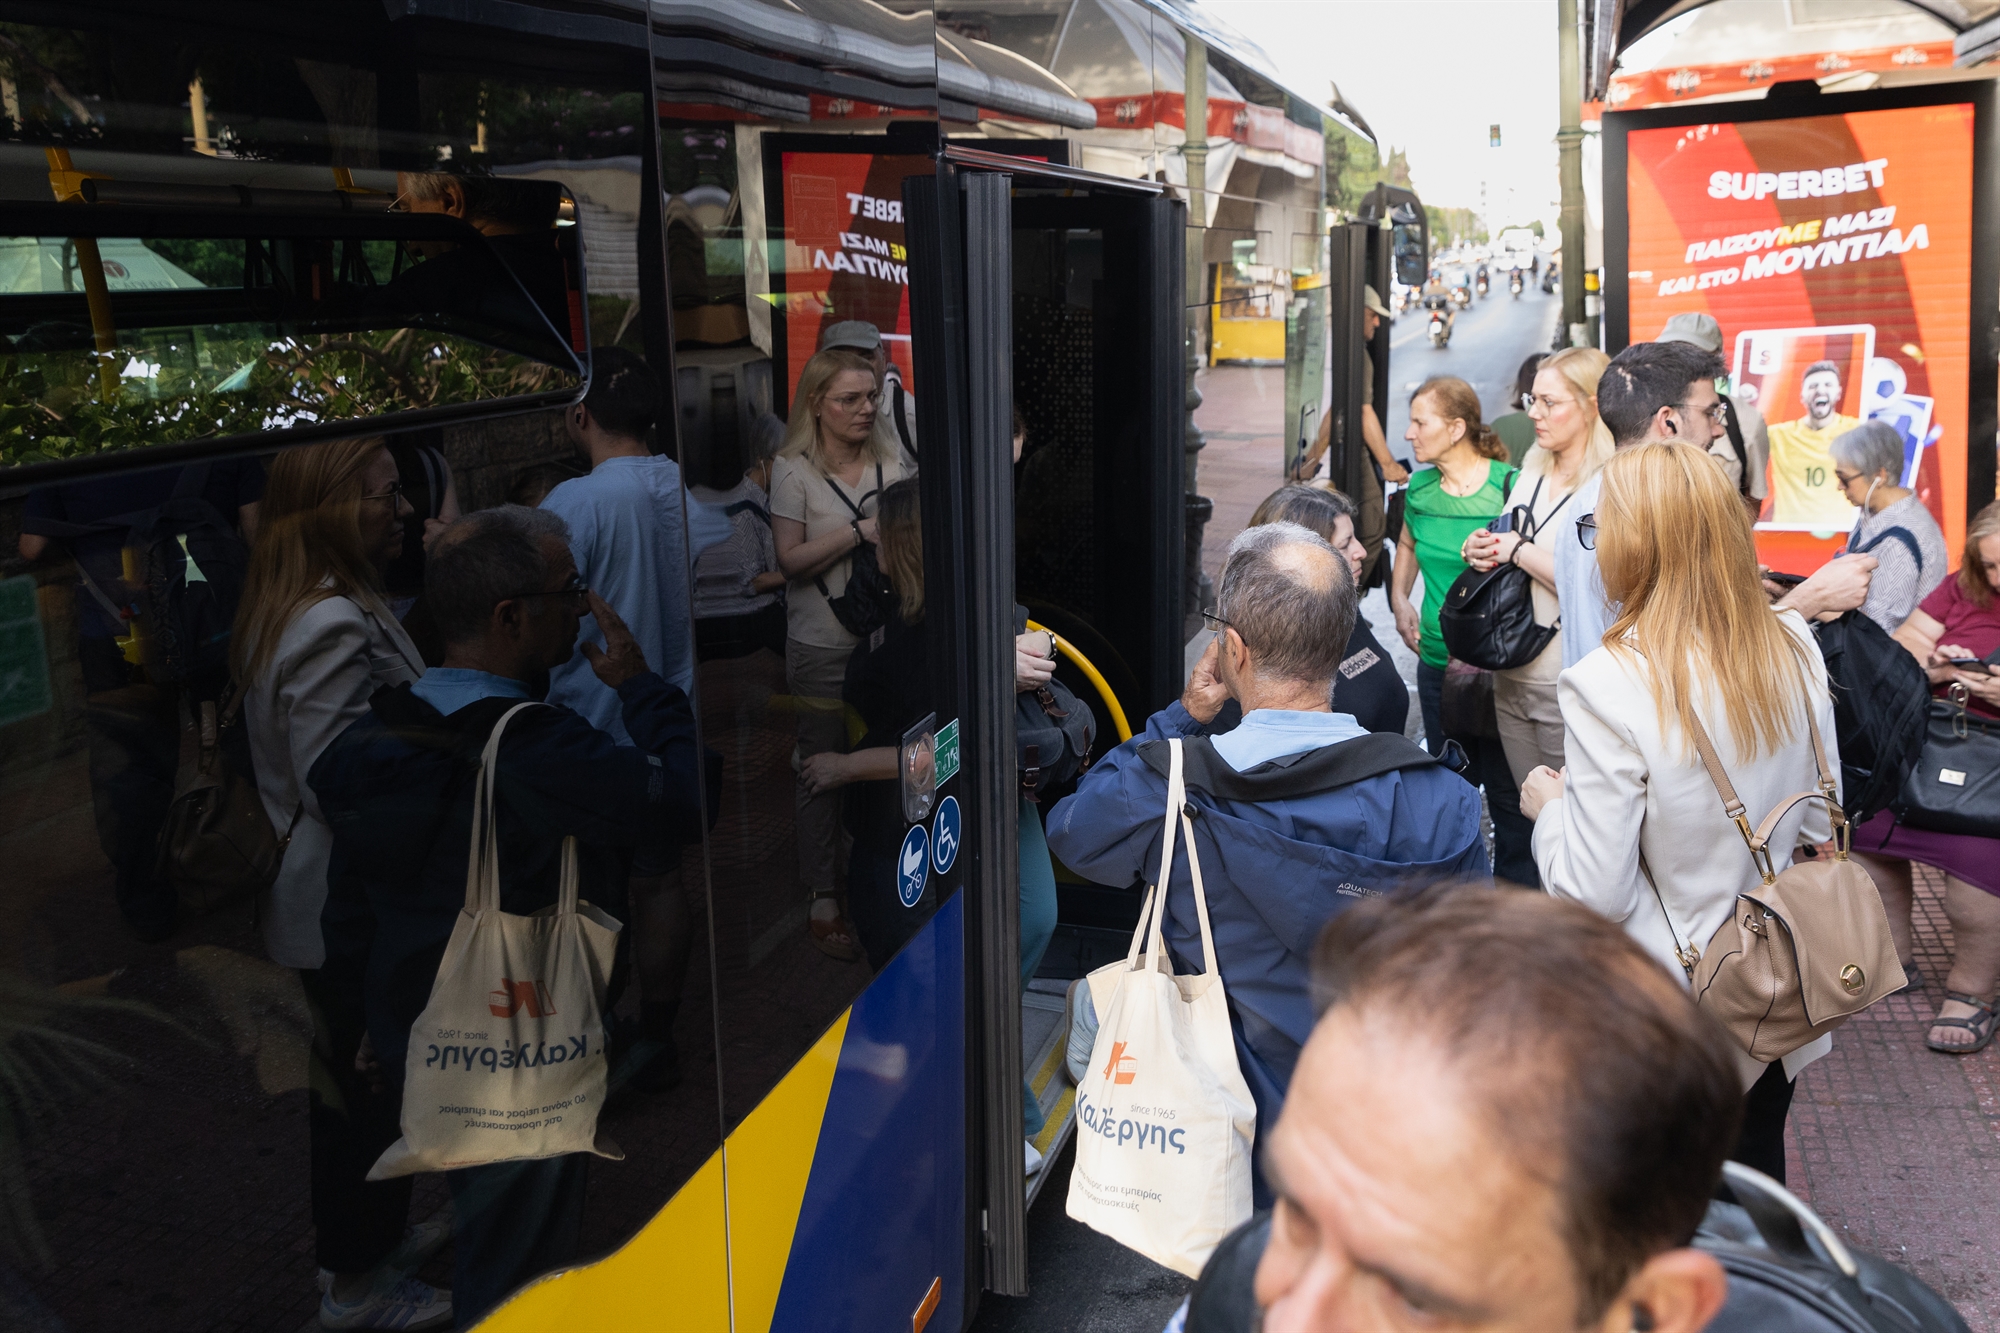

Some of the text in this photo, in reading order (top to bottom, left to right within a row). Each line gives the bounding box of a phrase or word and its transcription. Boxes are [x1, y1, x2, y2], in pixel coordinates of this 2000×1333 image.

[1707, 158, 1888, 200] SUPERBET
[1685, 206, 1896, 264] ΠΑΙΖΟΥΜΕ ΜΑΖΙ
[1658, 224, 1930, 296] ΚΑΙ ΣΤΟ ΜΟΥΝΤΙΑΛ
[1805, 466, 1826, 488] 10
[1337, 882, 1383, 898] AQUATECH
[1130, 1103, 1176, 1121] since 1965
[1121, 1187, 1162, 1203] εμπειρίας
